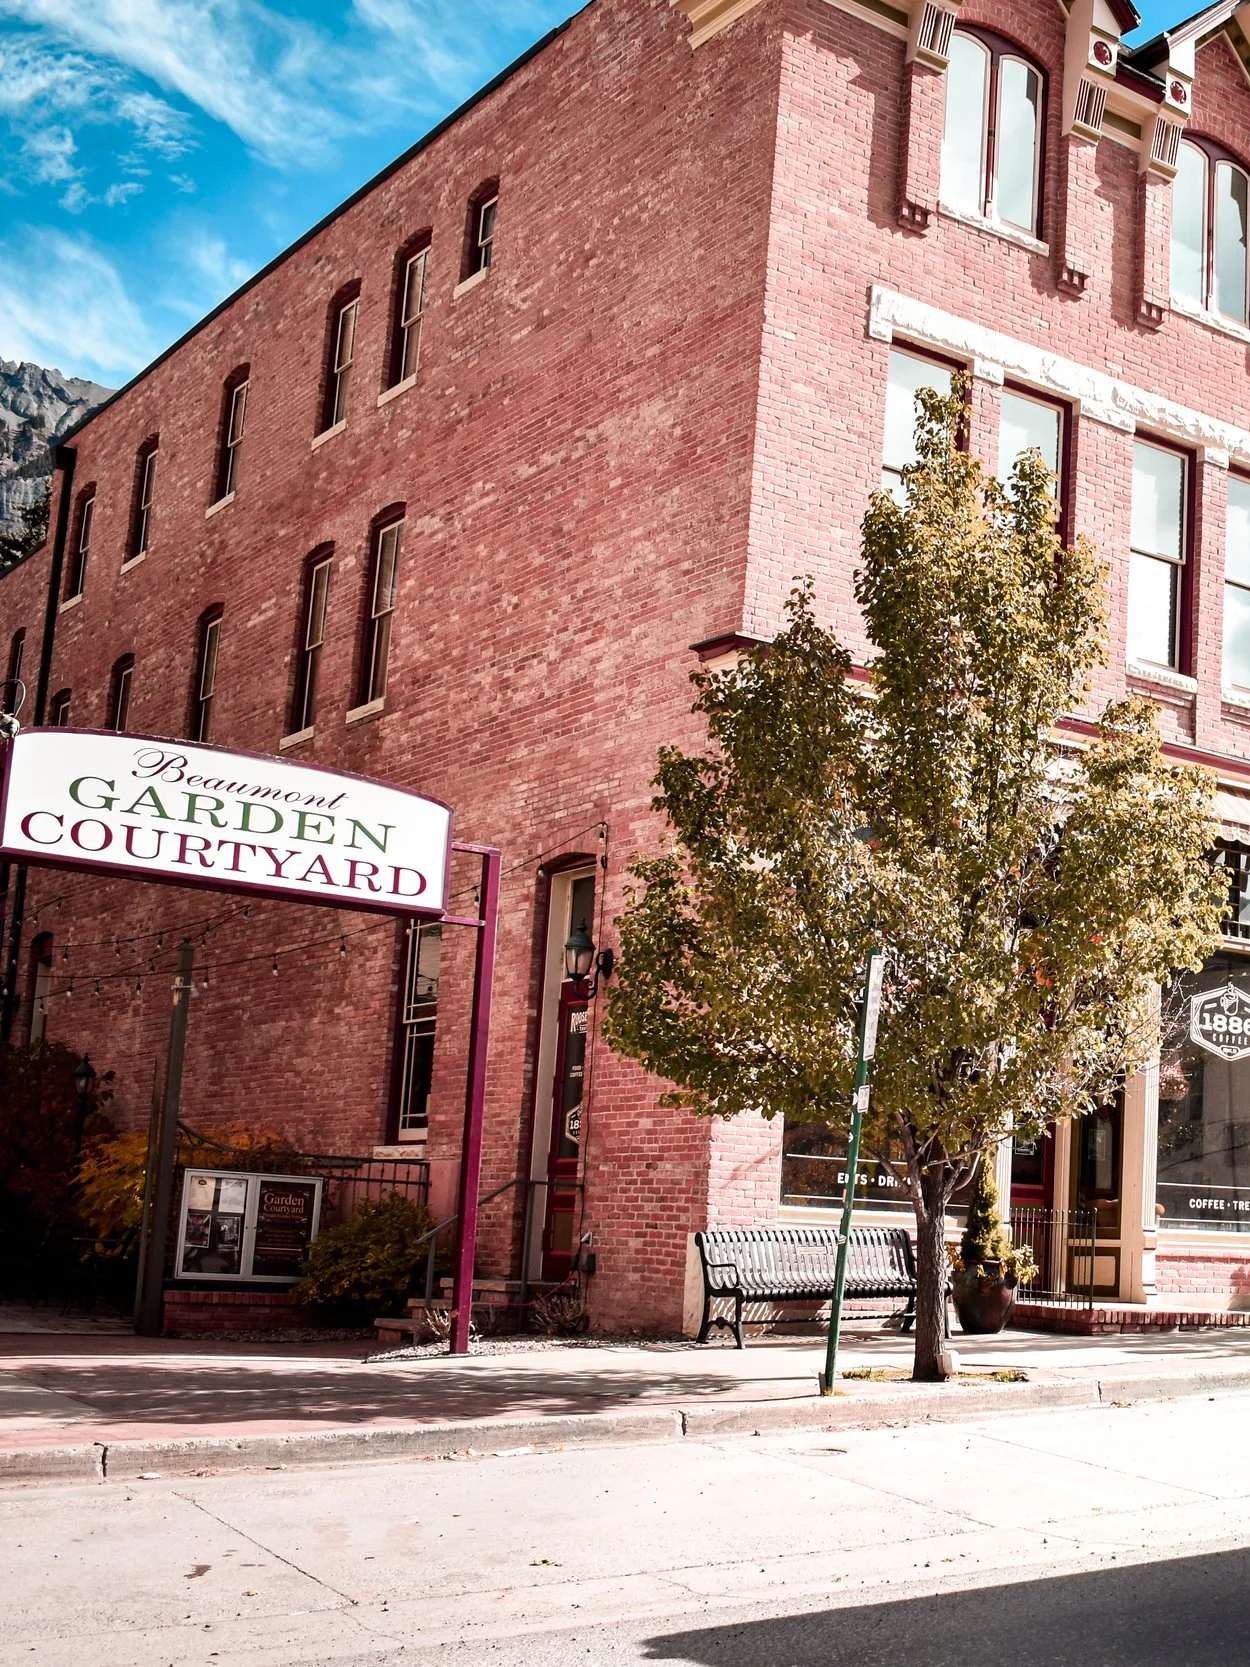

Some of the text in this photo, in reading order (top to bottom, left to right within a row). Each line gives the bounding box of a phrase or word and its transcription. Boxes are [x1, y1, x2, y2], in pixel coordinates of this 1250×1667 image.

[131, 747, 349, 810] Beaumont
[68, 775, 396, 853] GARDEN
[20, 811, 427, 898] COURTYARD
[1212, 1033, 1248, 1046] COFFEE
[569, 1119, 580, 1130] 18
[264, 1192, 304, 1206] Garden
[1189, 1198, 1225, 1210] COFFEE
[263, 1203, 304, 1214] Courtyard
